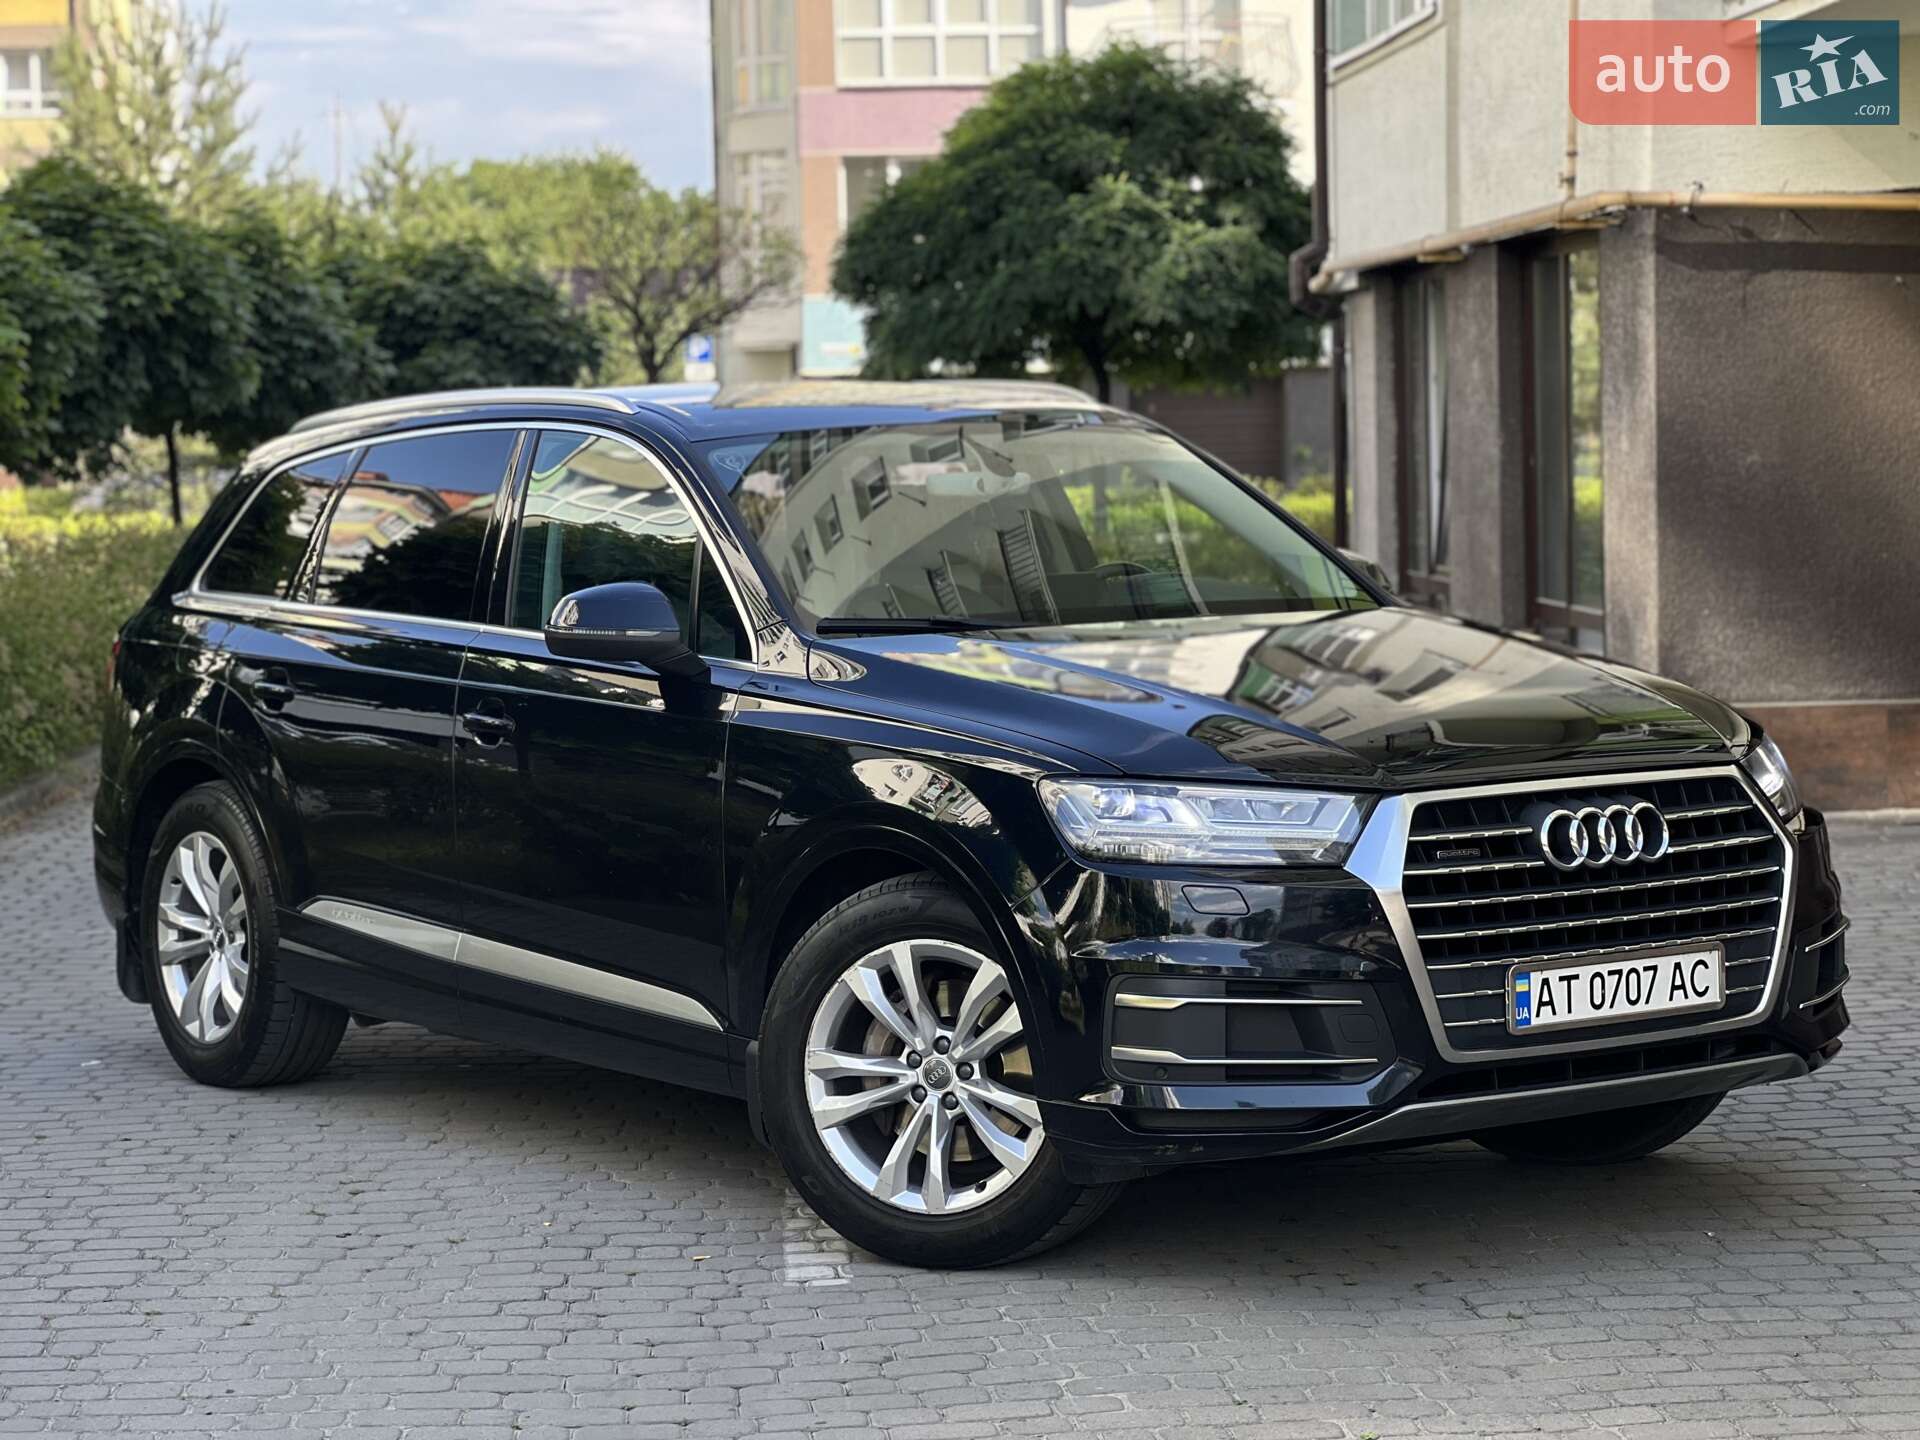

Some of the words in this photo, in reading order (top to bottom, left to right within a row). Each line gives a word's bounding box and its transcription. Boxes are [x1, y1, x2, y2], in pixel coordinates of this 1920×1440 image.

[1535, 973, 1580, 1018] AT
[1589, 964, 1659, 1011] 0707
[1668, 959, 1710, 1002] AC
[1516, 1007, 1529, 1020] UA
